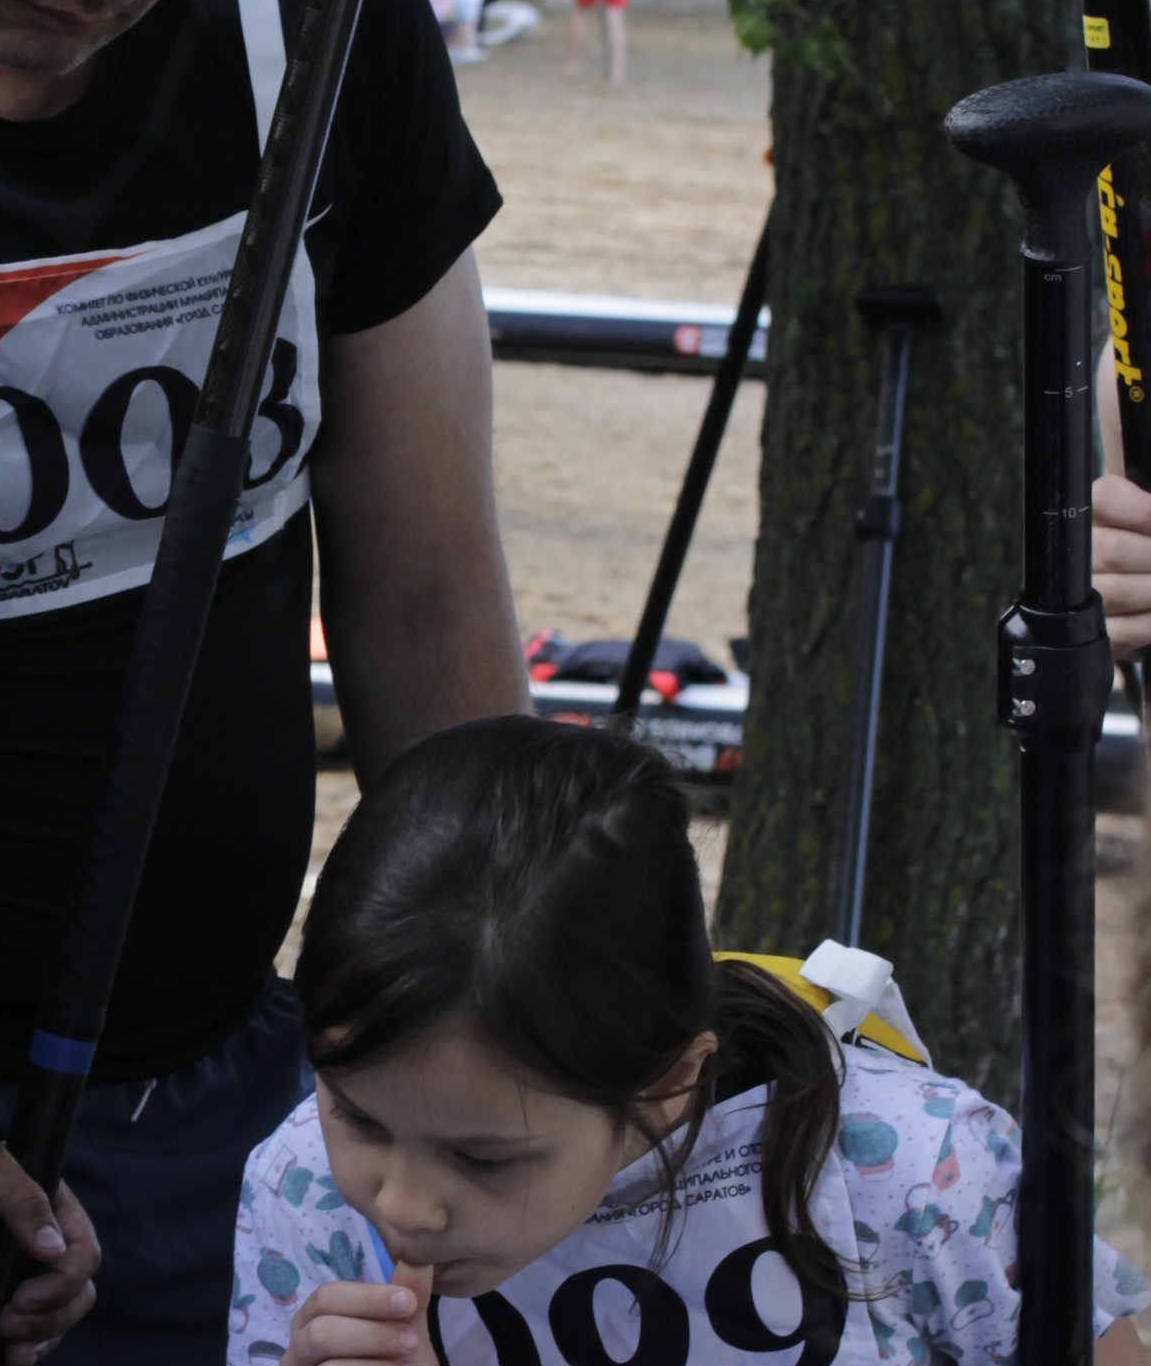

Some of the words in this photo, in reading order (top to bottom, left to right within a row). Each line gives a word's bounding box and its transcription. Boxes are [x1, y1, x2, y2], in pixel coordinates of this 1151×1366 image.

[1044, 273, 1063, 282] cm
[107, 294, 124, 307] ПО
[1064, 388, 1074, 399] 5
[1061, 507, 1077, 519] 10
